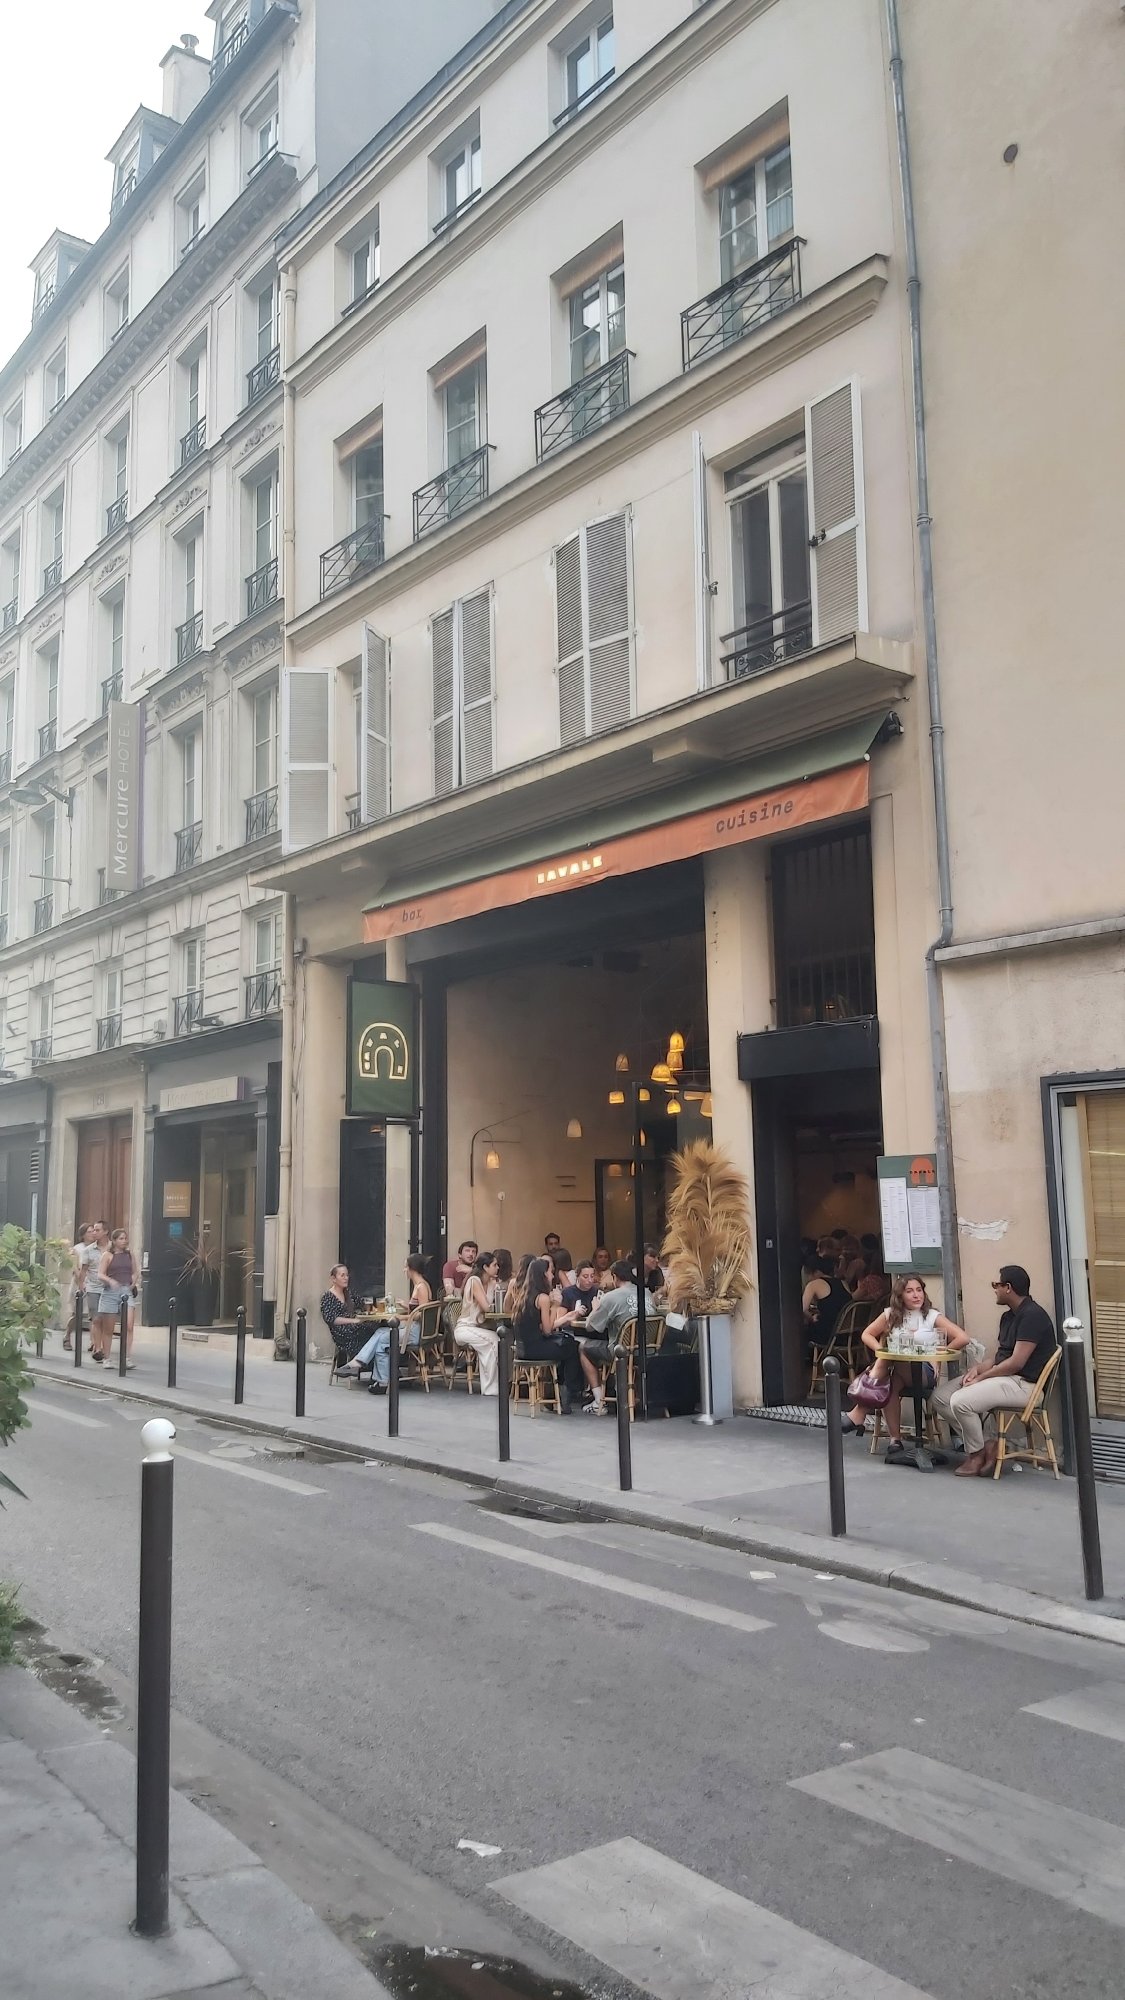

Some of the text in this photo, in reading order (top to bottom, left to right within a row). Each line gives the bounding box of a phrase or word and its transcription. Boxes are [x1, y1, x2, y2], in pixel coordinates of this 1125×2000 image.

[114, 719, 130, 875] Mercure HOTEL
[716, 800, 793, 833] cuisine
[402, 909, 423, 922] bar
